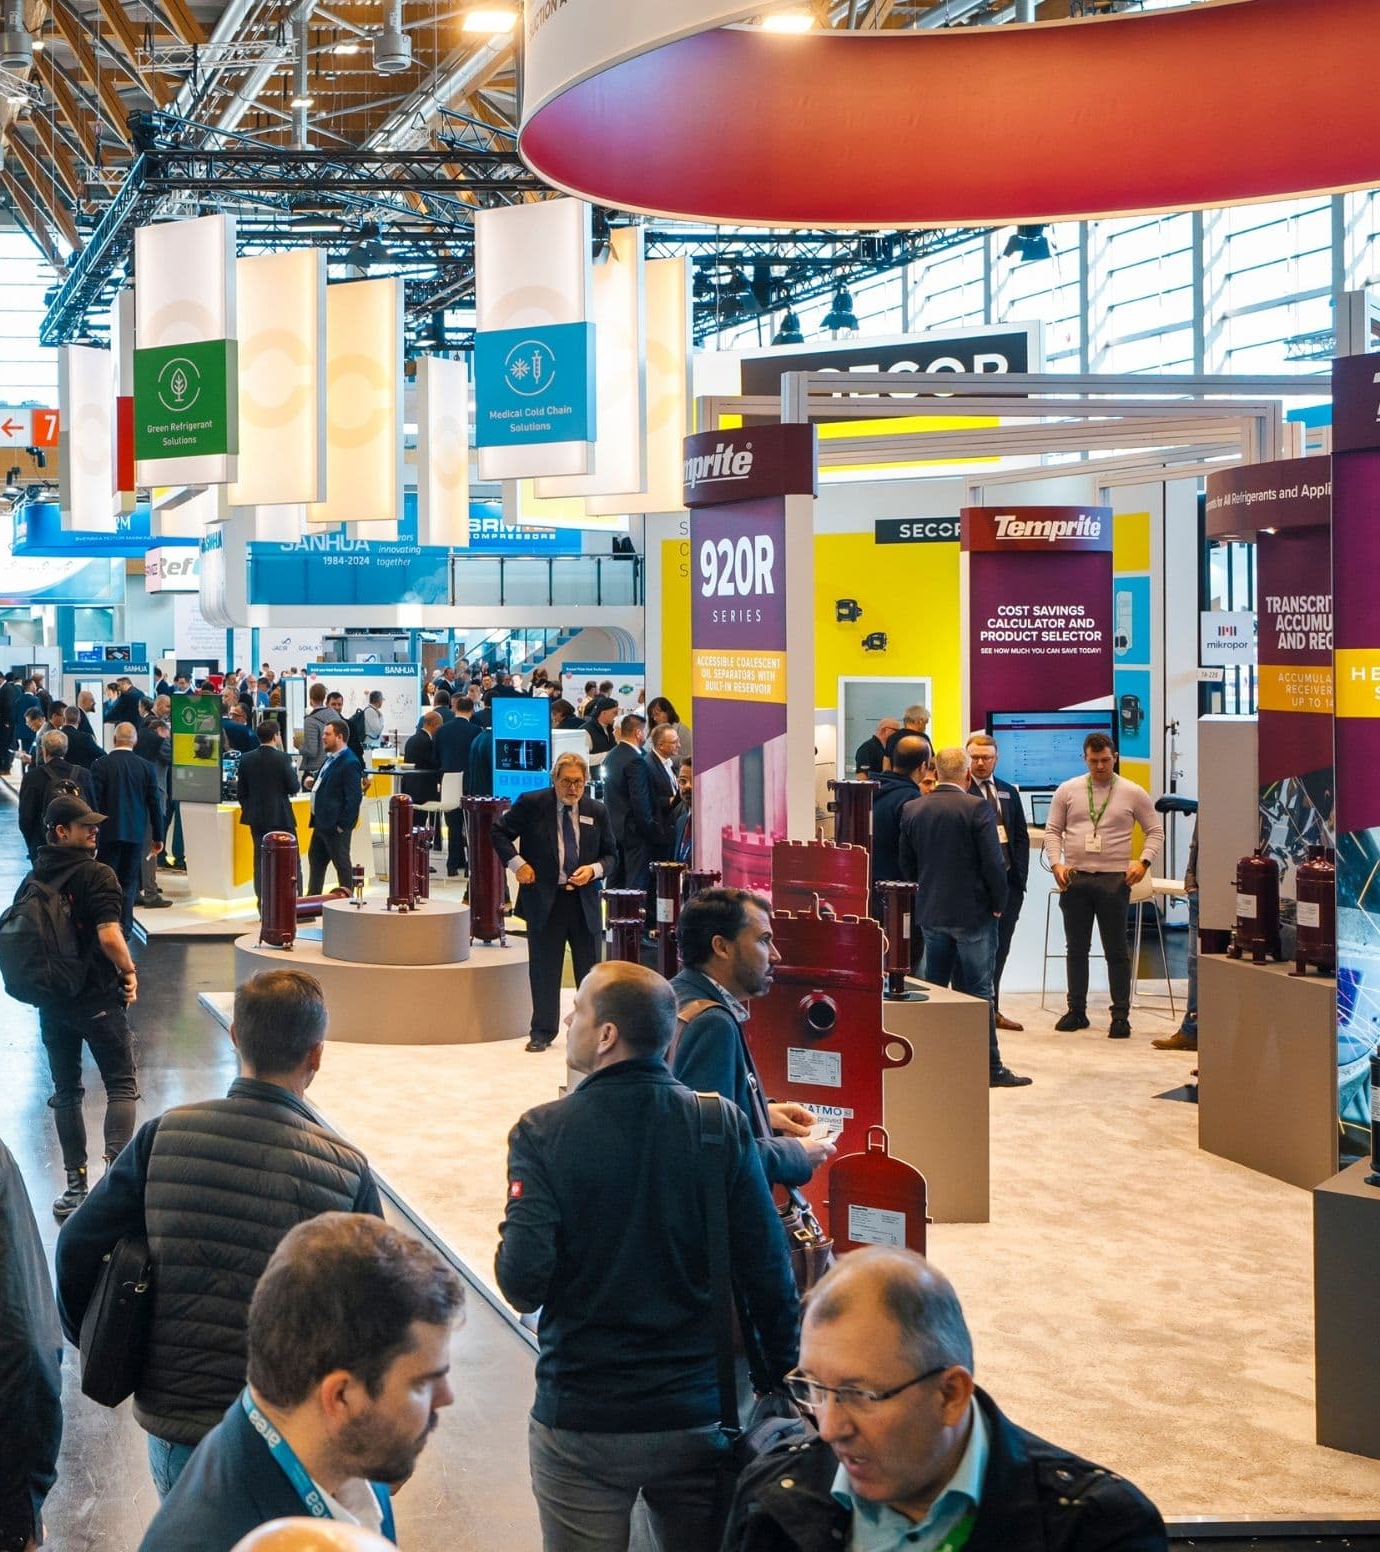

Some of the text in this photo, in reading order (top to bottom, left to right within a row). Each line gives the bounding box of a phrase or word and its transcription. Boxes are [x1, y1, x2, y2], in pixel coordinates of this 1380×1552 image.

[489, 404, 573, 420] Medical Cold Chain
[44, 414, 57, 441] 7
[147, 420, 213, 433] Green Refrigerant
[510, 421, 551, 433] Solutions
[162, 436, 197, 446] Solutions
[1231, 488, 1277, 505] Refrigerants
[1279, 485, 1298, 499] and
[378, 545, 421, 555] innovating
[323, 556, 370, 566] 1984-2024
[377, 558, 411, 567] together
[700, 534, 775, 598] 920R
[713, 609, 763, 624] SERIES
[997, 606, 1085, 616] COST SAVINGS
[987, 618, 1095, 629] CALCULATOR AND
[980, 631, 1102, 641] PRODUCT SELECTOR
[1277, 633, 1306, 650] AND
[1206, 640, 1248, 651] mikropor
[697, 655, 781, 669] ACCESSIBLE COALESCENT
[123, 665, 148, 673] SANHUA
[701, 668, 776, 682] OIL SEPARATORS WITH
[705, 681, 772, 696] BUILT-IN RESERVOIR
[1291, 698, 1305, 707] UP
[1308, 698, 1320, 708] TO
[248, 1410, 281, 1448] area
